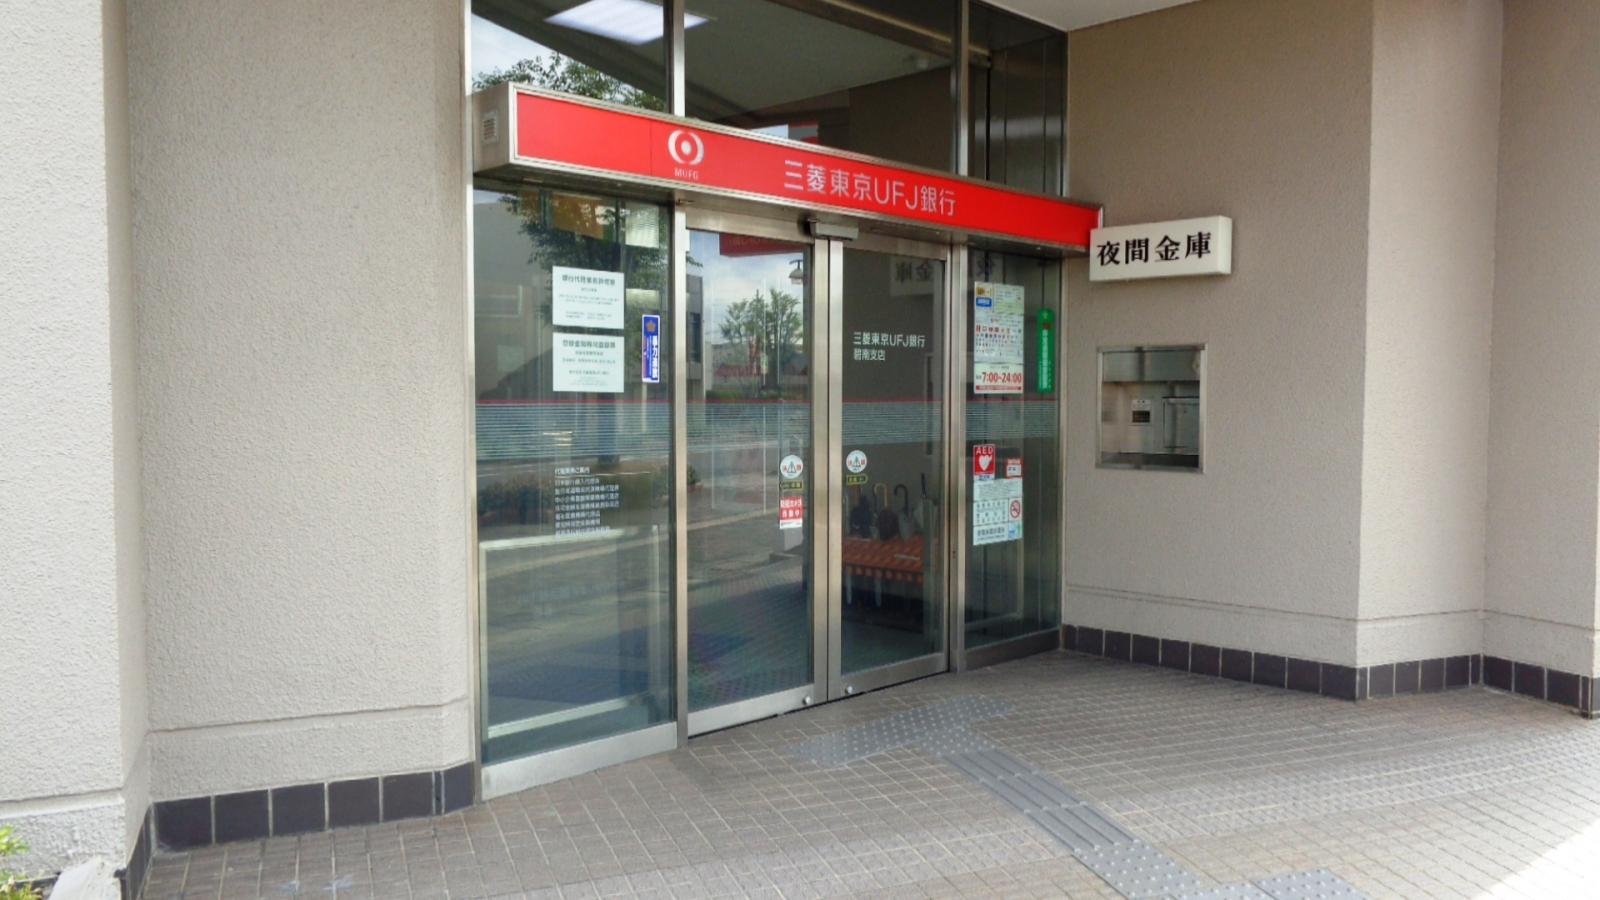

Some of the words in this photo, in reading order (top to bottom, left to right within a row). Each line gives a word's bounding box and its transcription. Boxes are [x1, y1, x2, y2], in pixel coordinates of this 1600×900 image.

[674, 168, 699, 181] MUFG
[783, 159, 957, 218] 三菱東京UFJ銀行
[1097, 231, 1212, 267] 夜間金庫
[853, 331, 926, 348] 三菱東京UFJ銀行
[975, 446, 994, 455] AED
